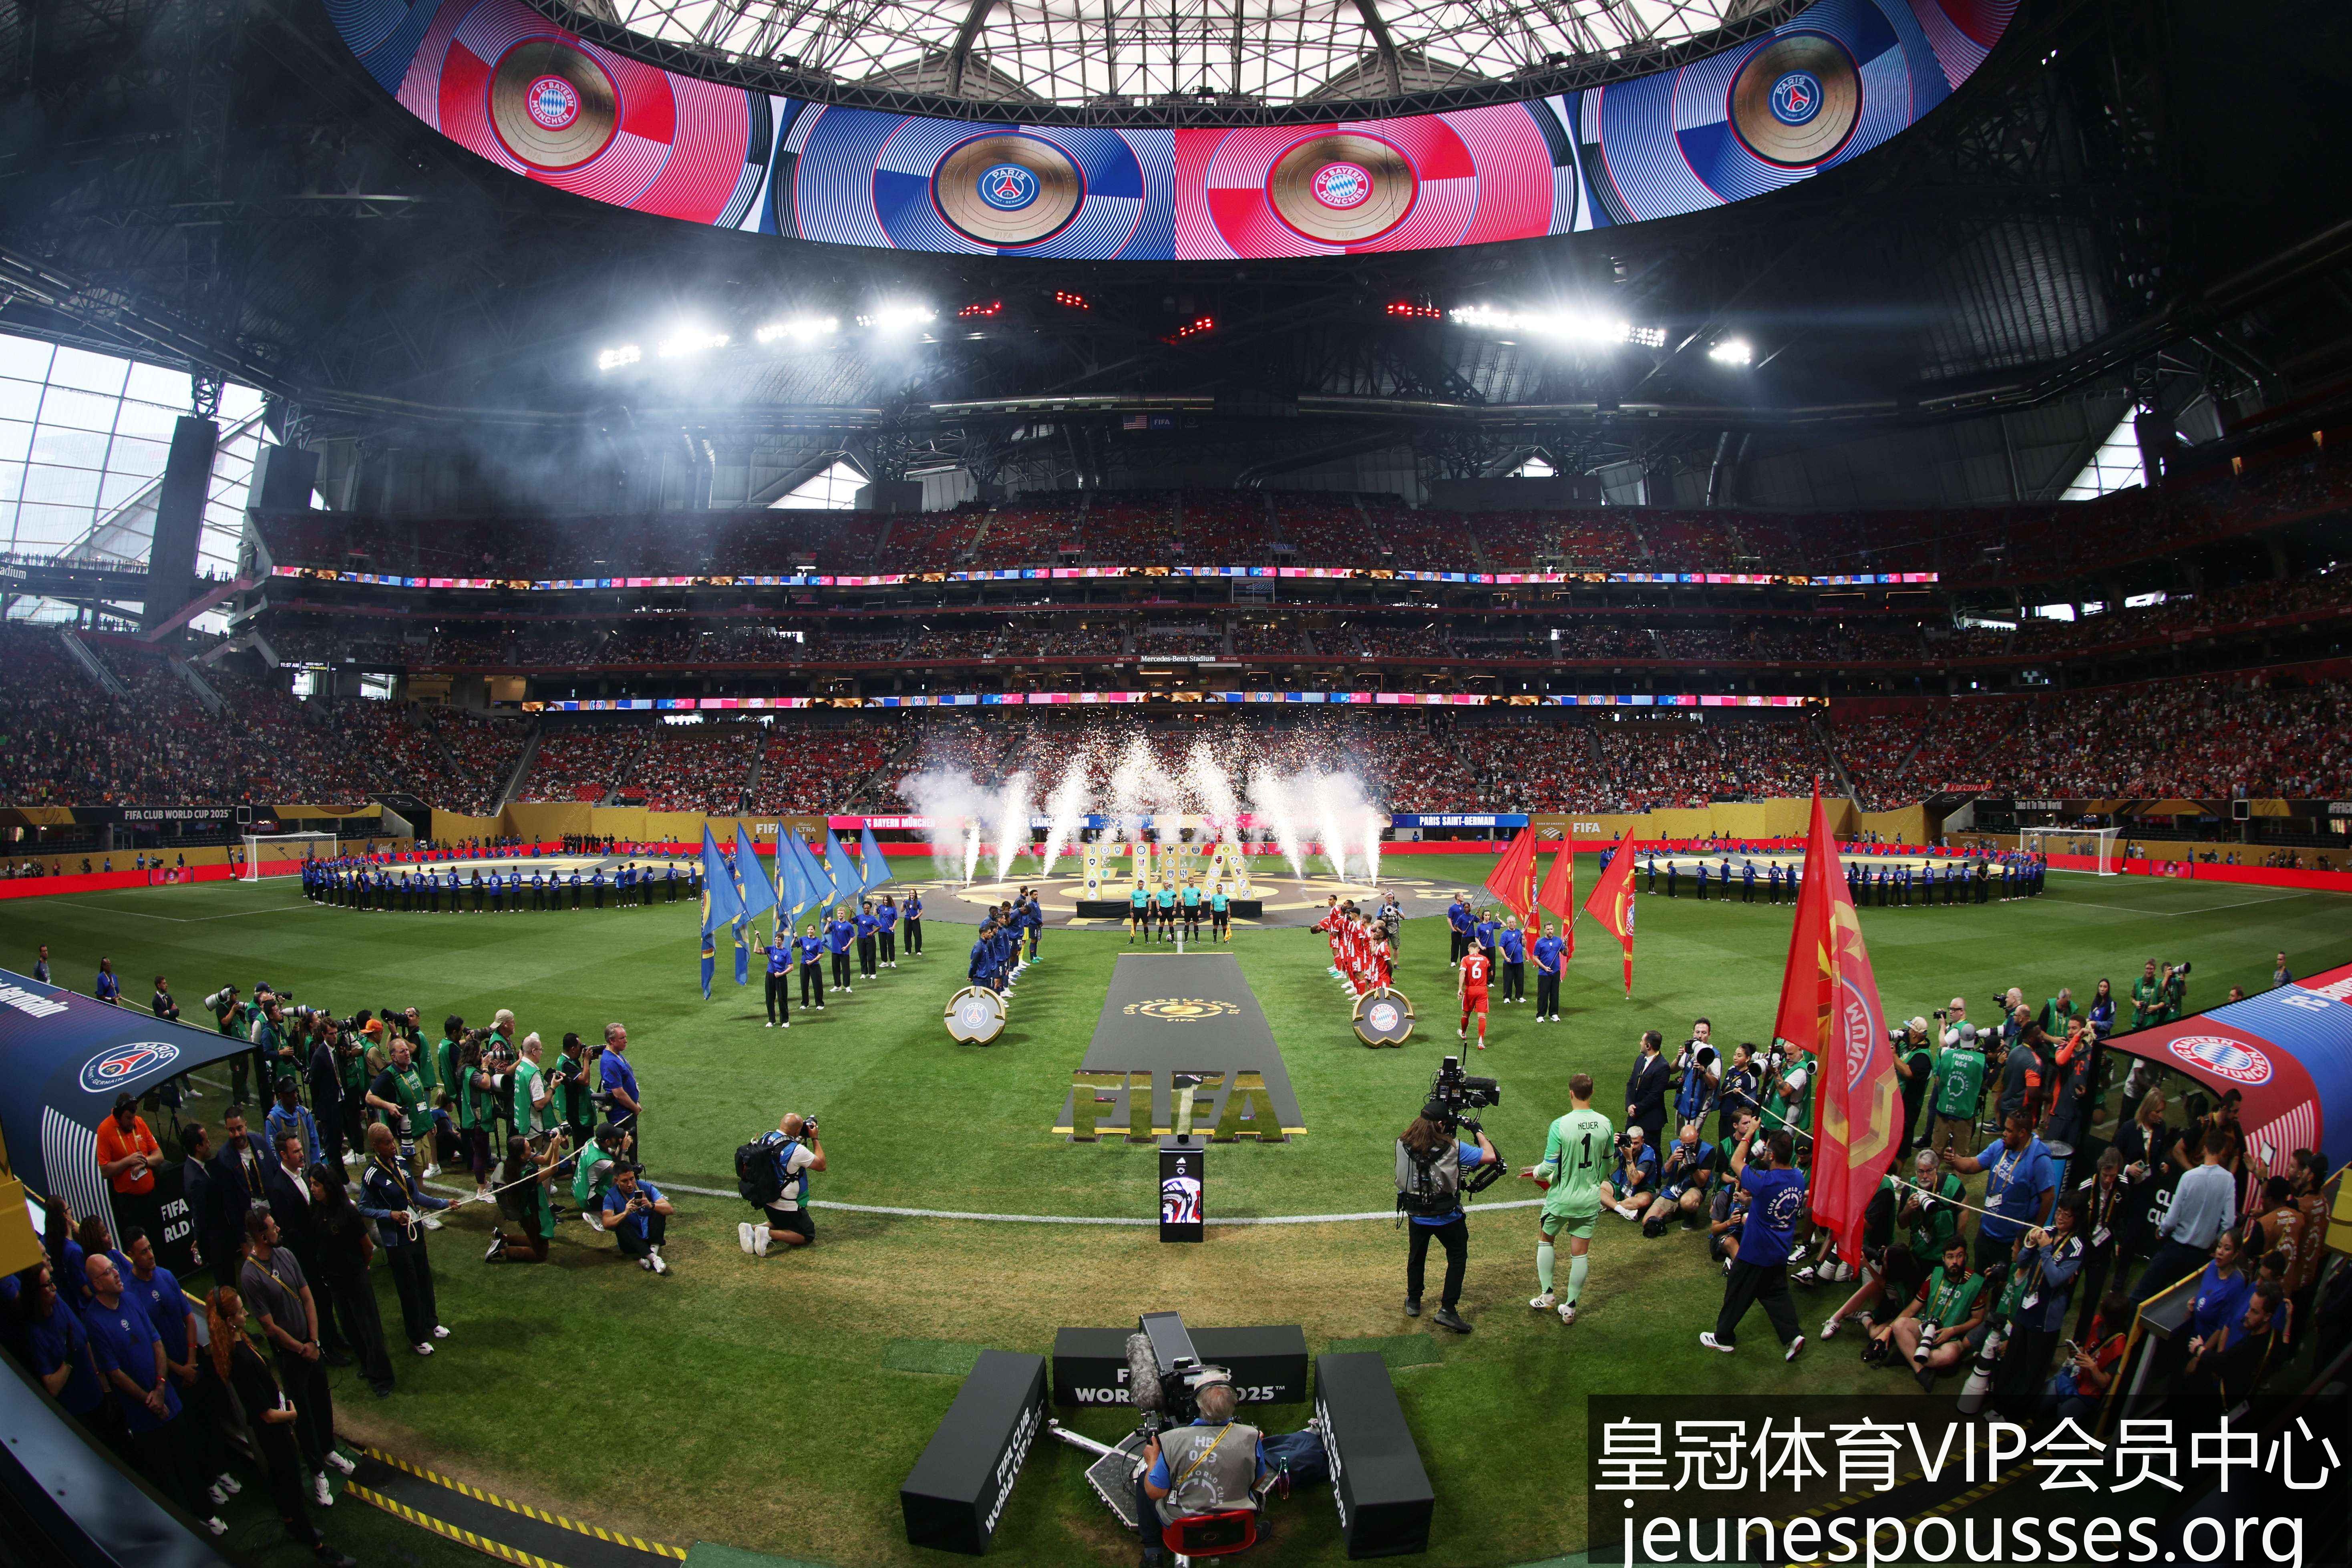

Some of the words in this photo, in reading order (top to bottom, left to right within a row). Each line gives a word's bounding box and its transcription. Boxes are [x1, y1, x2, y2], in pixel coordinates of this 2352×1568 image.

[1777, 77, 1805, 94] PARIS
[536, 83, 547, 94] FC
[548, 82, 574, 107] BAYERN
[531, 99, 570, 124] MÜNCHEN
[991, 169, 1027, 181] PARIS
[1319, 174, 1329, 185] FC
[1329, 167, 1364, 183] BAYERN
[1320, 188, 1365, 205] MÜNCHEN
[2031, 800, 2038, 810] To
[2038, 800, 2047, 810] The
[2047, 800, 2062, 810] World
[125, 810, 143, 820] FIFA
[144, 810, 164, 820] CLUB
[165, 810, 193, 820] WORLD
[194, 810, 209, 819] CUP
[873, 818, 899, 828] BAYERN
[901, 816, 936, 828] MÜNCHEN
[1419, 816, 1440, 826] PARIS
[1442, 816, 1495, 826] SAINT-GERMAIN
[1573, 822, 1601, 833] FIFA
[1472, 961, 1482, 979] 6
[1123, 1004, 1140, 1015] CLUB
[1376, 1005, 1396, 1016] BAYERN
[1372, 1019, 1396, 1030] MÜNCHEN
[133, 1043, 174, 1059] PARIS
[2180, 1037, 2235, 1050] BAYERN
[1952, 1052, 1974, 1062] PHOTO
[2176, 1047, 2198, 1061] FC
[2211, 1050, 2268, 1081] MÜNCHEN
[92, 1076, 124, 1086] GERMAIN
[1072, 1070, 1284, 1142] FIFA
[1578, 1121, 1598, 1130] NEUER
[1578, 1133, 1592, 1169] 1
[1767, 1198, 1778, 1215] CLUB
[1778, 1186, 1798, 1198] WORLD
[161, 1198, 189, 1221] FIFA
[1075, 1388, 1131, 1403] WOR
[1236, 1385, 1286, 1402] 025™
[1316, 1397, 1328, 1451] WORLD
[997, 1445, 1013, 1486] FIFA
[1013, 1407, 1030, 1450] CLUB
[1195, 1435, 1216, 1449] HB
[1322, 1399, 1331, 1440] FIFA
[1330, 1432, 1341, 1478] CLUB
[1187, 1470, 1218, 1484] WORLD
[985, 1471, 1014, 1534] WORLD
[1013, 1439, 1026, 1474] CUP
